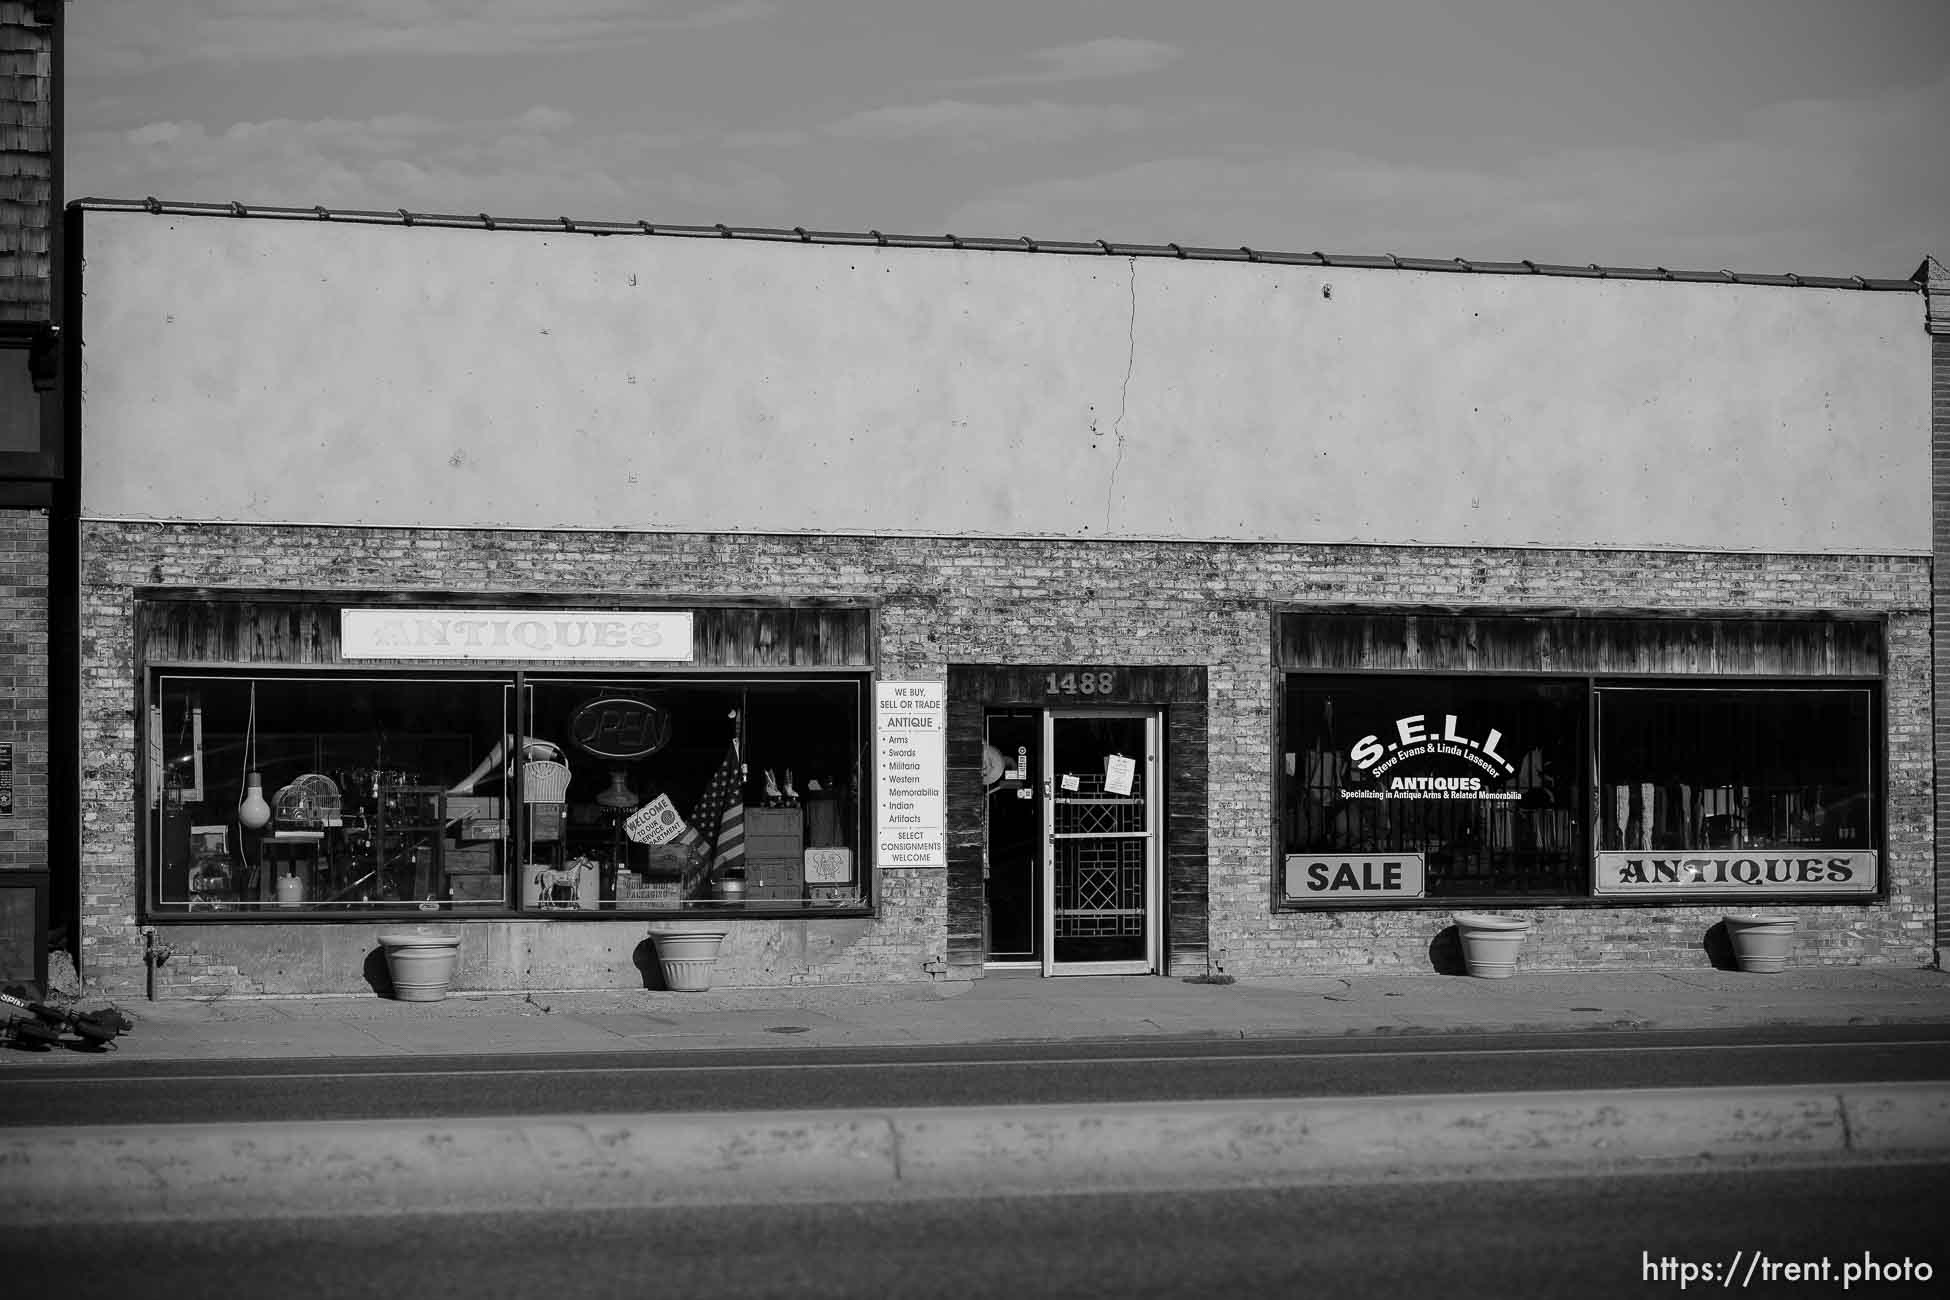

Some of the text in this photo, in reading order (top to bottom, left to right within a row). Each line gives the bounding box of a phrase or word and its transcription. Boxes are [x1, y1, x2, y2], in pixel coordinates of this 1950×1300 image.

[375, 618, 663, 651] ANTIQUES
[1046, 672, 1113, 695] 1488
[894, 687, 926, 698] WE BUY,
[880, 700, 941, 709] SELL OR TRADE
[573, 709, 668, 746] OPEN
[887, 717, 934, 728] ANTIQUE
[888, 735, 909, 744] Arms
[1350, 714, 1515, 774] S.E.L.L.
[888, 748, 916, 758] Swords
[888, 761, 921, 770] Militaria
[1371, 743, 1500, 779] Steve Evans & Linda Lasseter
[888, 775, 921, 784] Western
[1390, 776, 1482, 791] ANTIQUES
[889, 788, 939, 797] Memorabilia
[1340, 789, 1523, 800] Specializing in Antique Arms & Related Memorabilia
[889, 801, 915, 810] Indian
[626, 799, 669, 832] WELCOME
[888, 814, 921, 823] Artifacts
[637, 820, 659, 838] TO OUR
[897, 831, 924, 840] SELECT
[880, 843, 942, 851] CONSIGNMENTS
[892, 854, 931, 862] WELCOME
[1306, 862, 1402, 892] SALE
[1619, 858, 1854, 886] ANTIQUES
